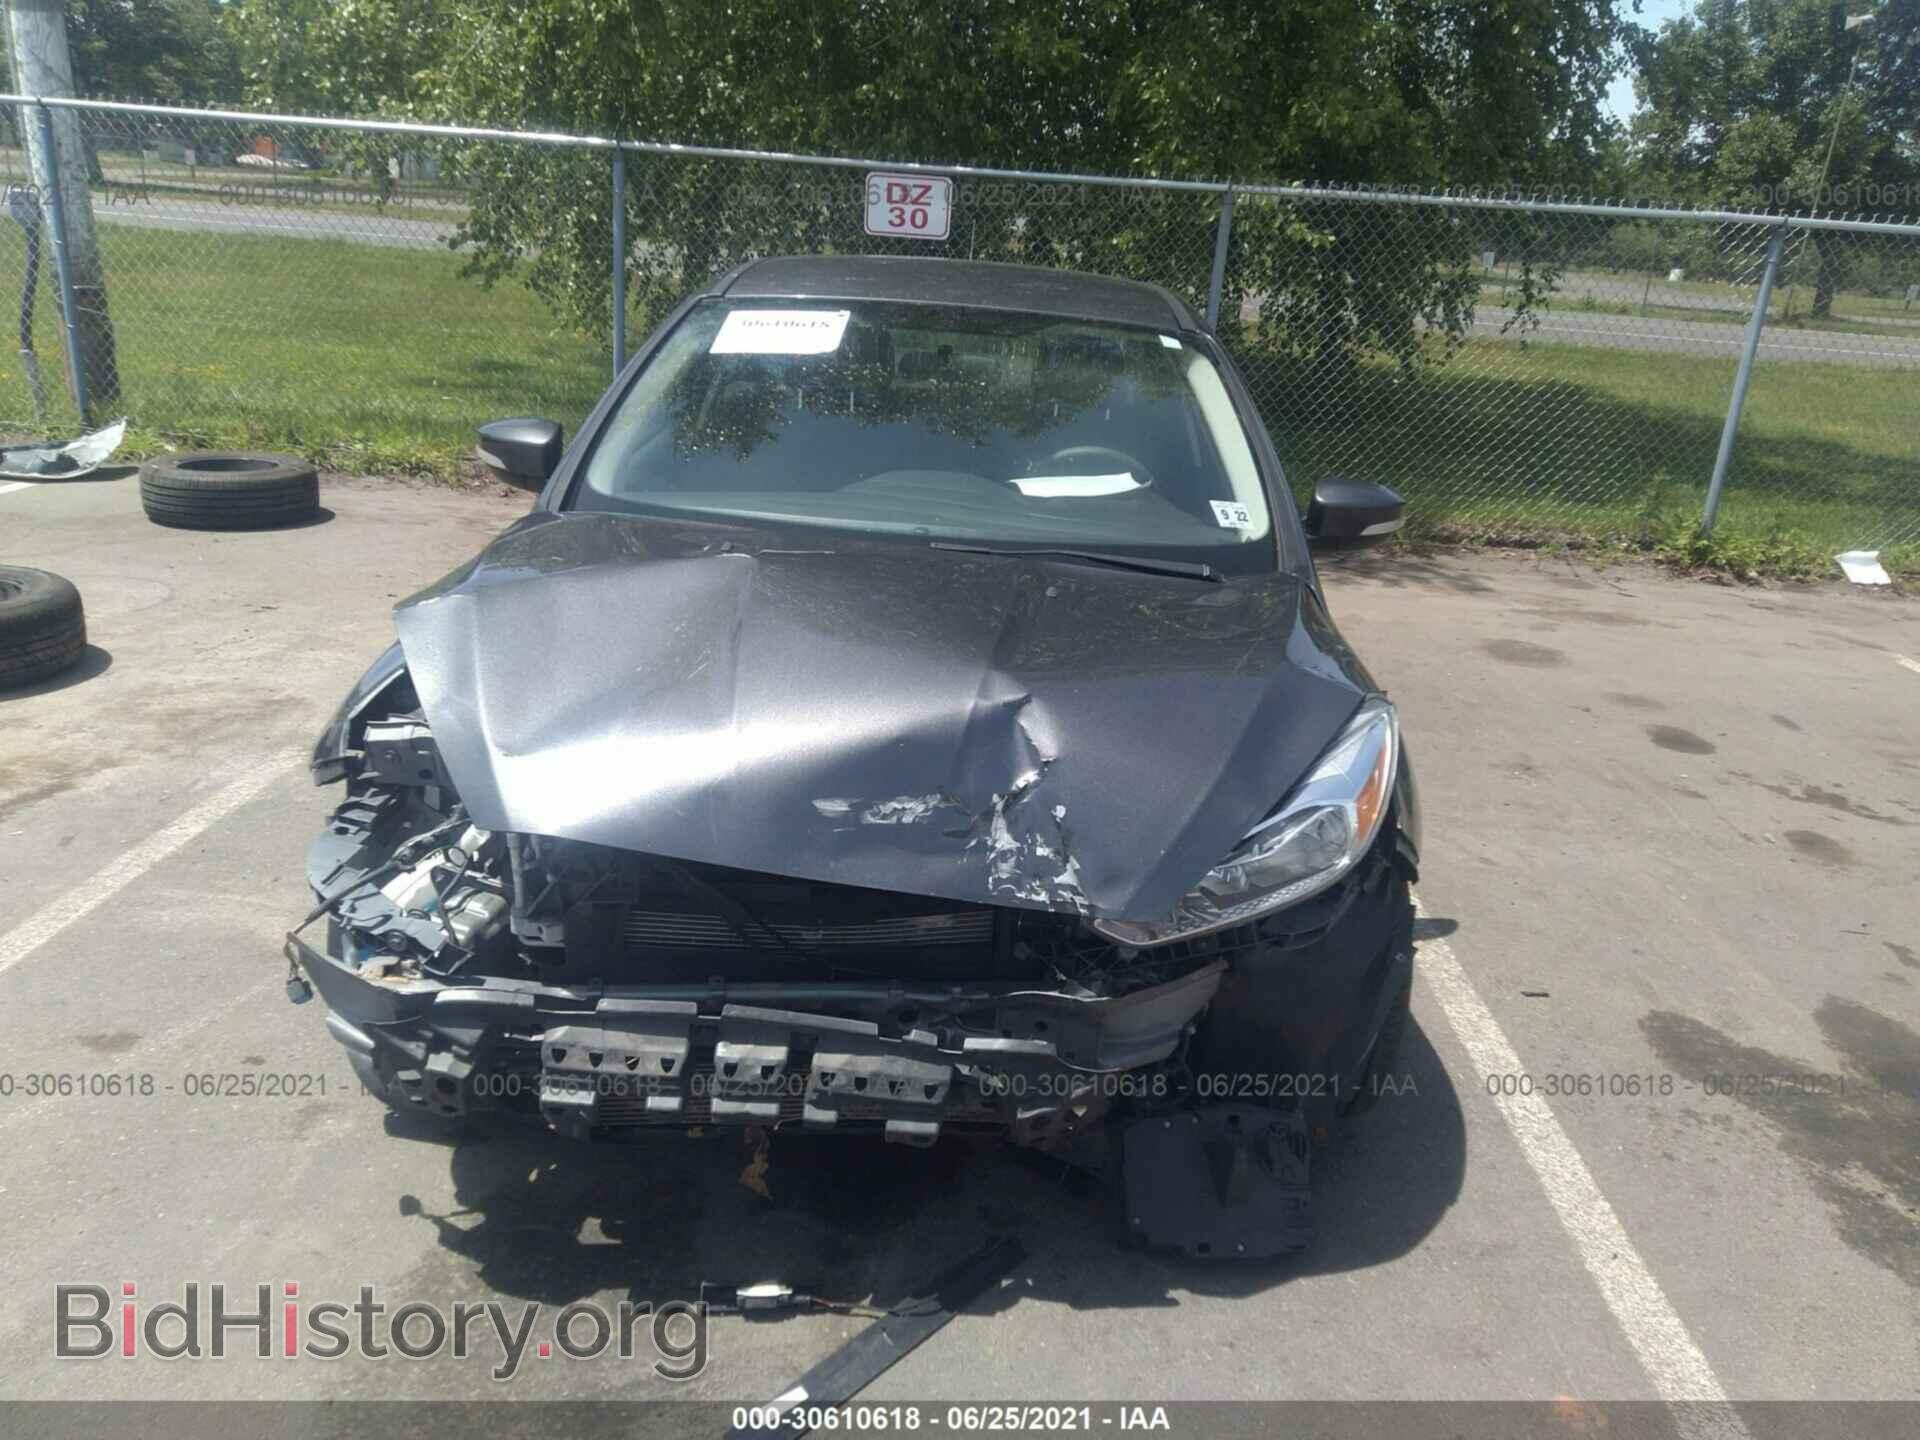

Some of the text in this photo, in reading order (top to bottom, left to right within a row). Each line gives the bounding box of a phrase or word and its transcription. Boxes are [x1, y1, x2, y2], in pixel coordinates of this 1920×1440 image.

[886, 182, 932, 206] DZ
[888, 207, 928, 229] 30
[1234, 510, 1249, 522] 22
